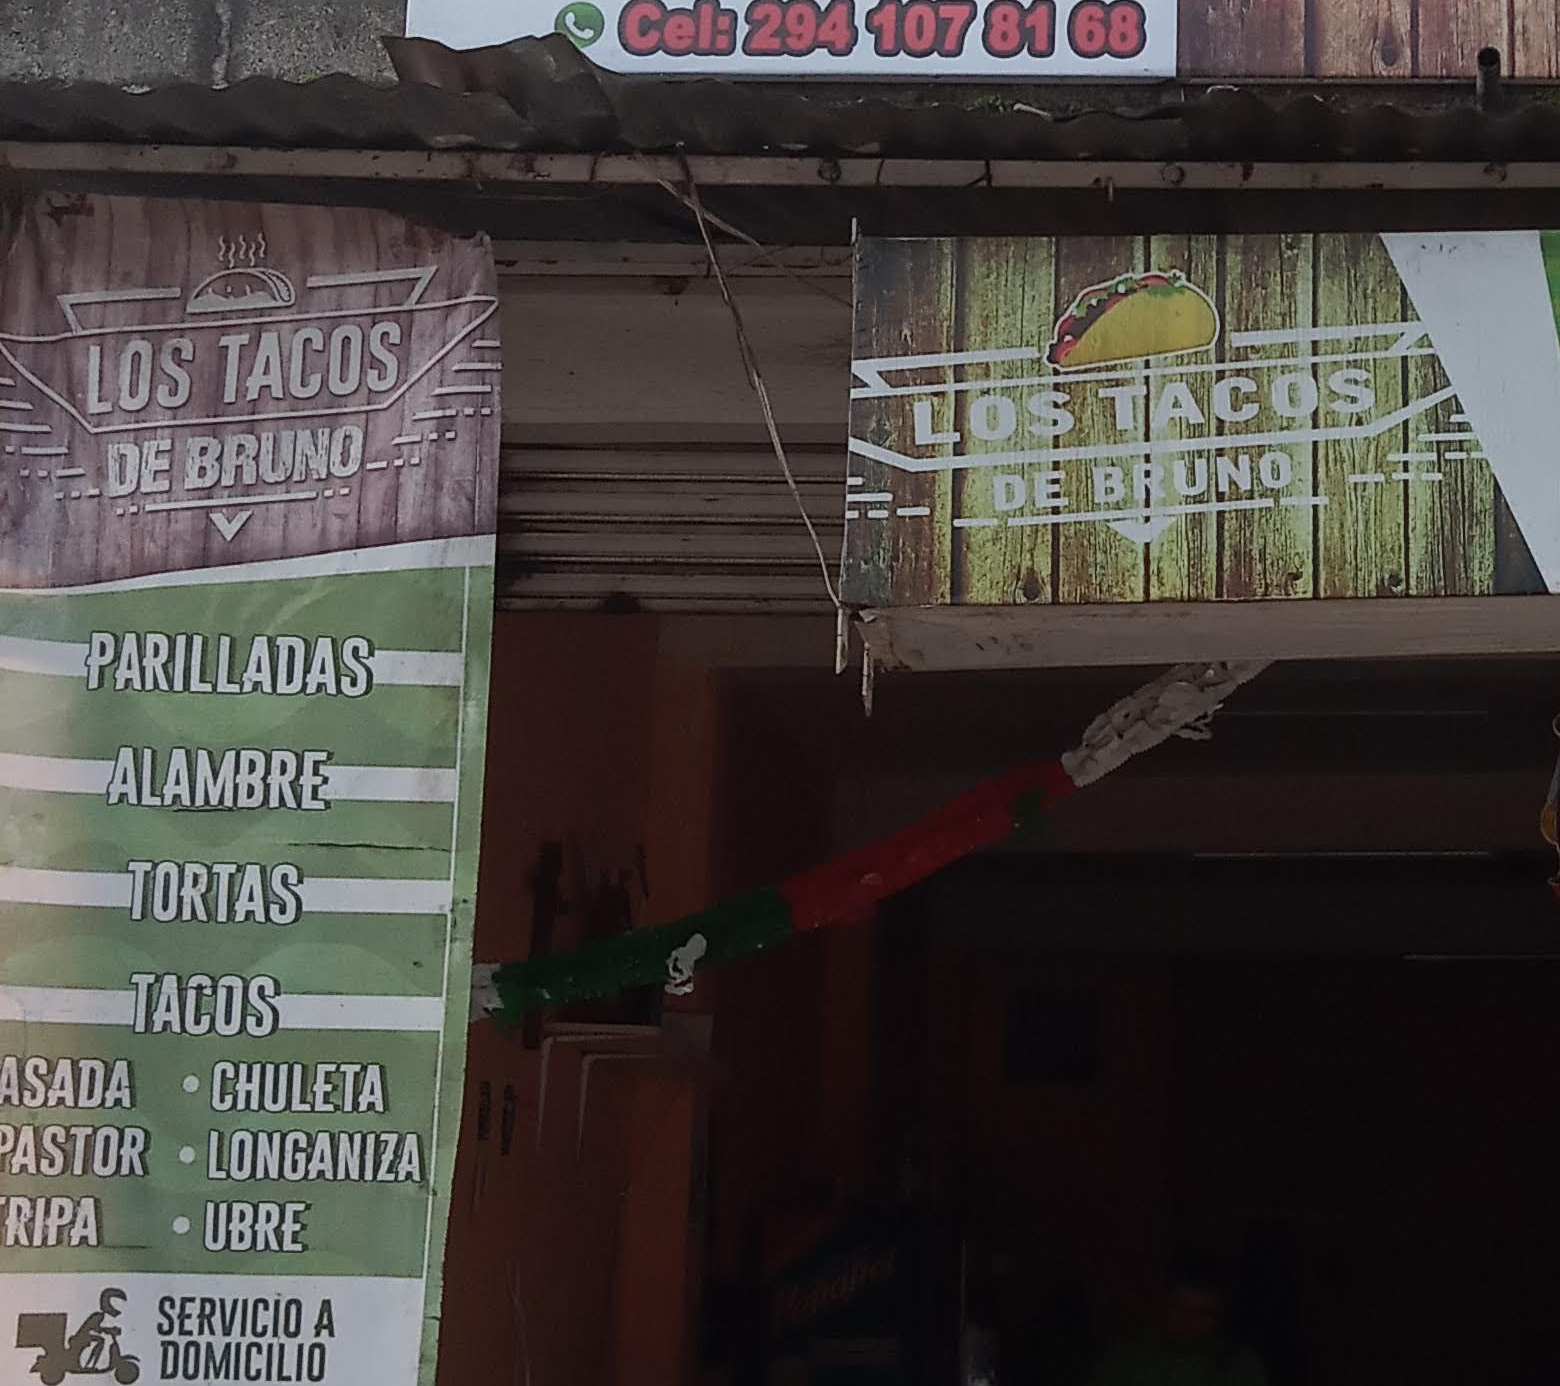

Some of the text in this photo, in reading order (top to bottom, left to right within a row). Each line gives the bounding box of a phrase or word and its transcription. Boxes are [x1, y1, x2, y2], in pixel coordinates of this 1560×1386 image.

[620, 0, 1144, 56] Cel: 294 107 81 68
[88, 321, 400, 414] LOS TACOS
[912, 369, 1374, 446] LOS TACOS
[107, 424, 364, 498] DE BRUNO
[993, 452, 1292, 512] DE BRUNO
[86, 632, 373, 696] PARILLADAS
[106, 747, 331, 811] ALAMBRE
[129, 861, 304, 924] TORTAS
[131, 973, 280, 1036] TACOS
[0, 1056, 385, 1113] ASADA CHULETA
[207, 1129, 422, 1182] LONGANIZA
[203, 1201, 307, 1252] UBRE
[157, 1292, 335, 1339] SERVICIO A
[160, 1341, 326, 1382] DOMICILIO
